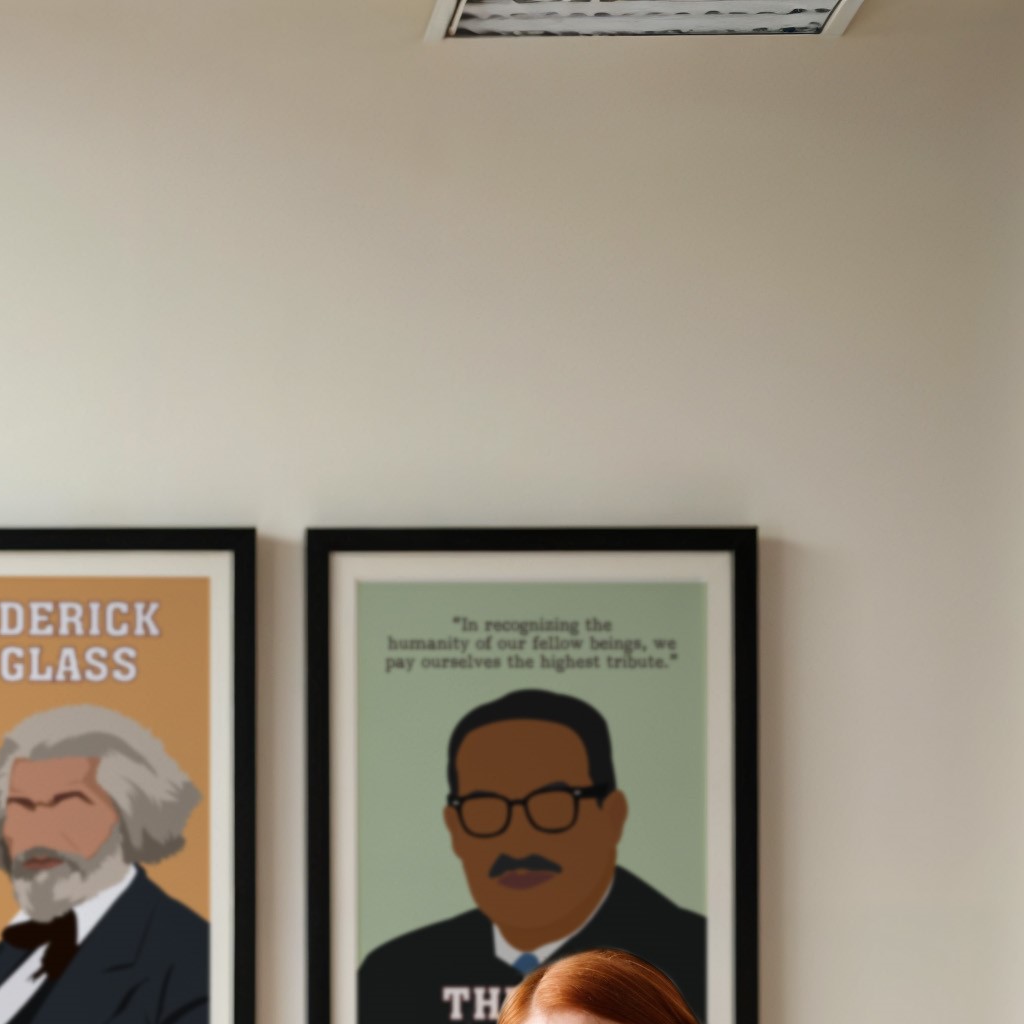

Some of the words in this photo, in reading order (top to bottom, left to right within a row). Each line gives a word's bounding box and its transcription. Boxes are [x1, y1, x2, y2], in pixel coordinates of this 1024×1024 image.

[452, 616, 479, 632] "In
[484, 616, 580, 636] recognizing
[584, 616, 613, 632] the
[387, 636, 469, 654] humanity
[475, 636, 493, 651] of
[497, 638, 527, 651] our
[532, 636, 583, 651] fellow
[590, 636, 647, 655] beings,
[653, 639, 677, 651] we
[384, 657, 415, 674] pay
[420, 654, 502, 670] ourselves
[507, 654, 534, 670] the
[540, 654, 601, 673] highest
[606, 653, 679, 670] tribute."
